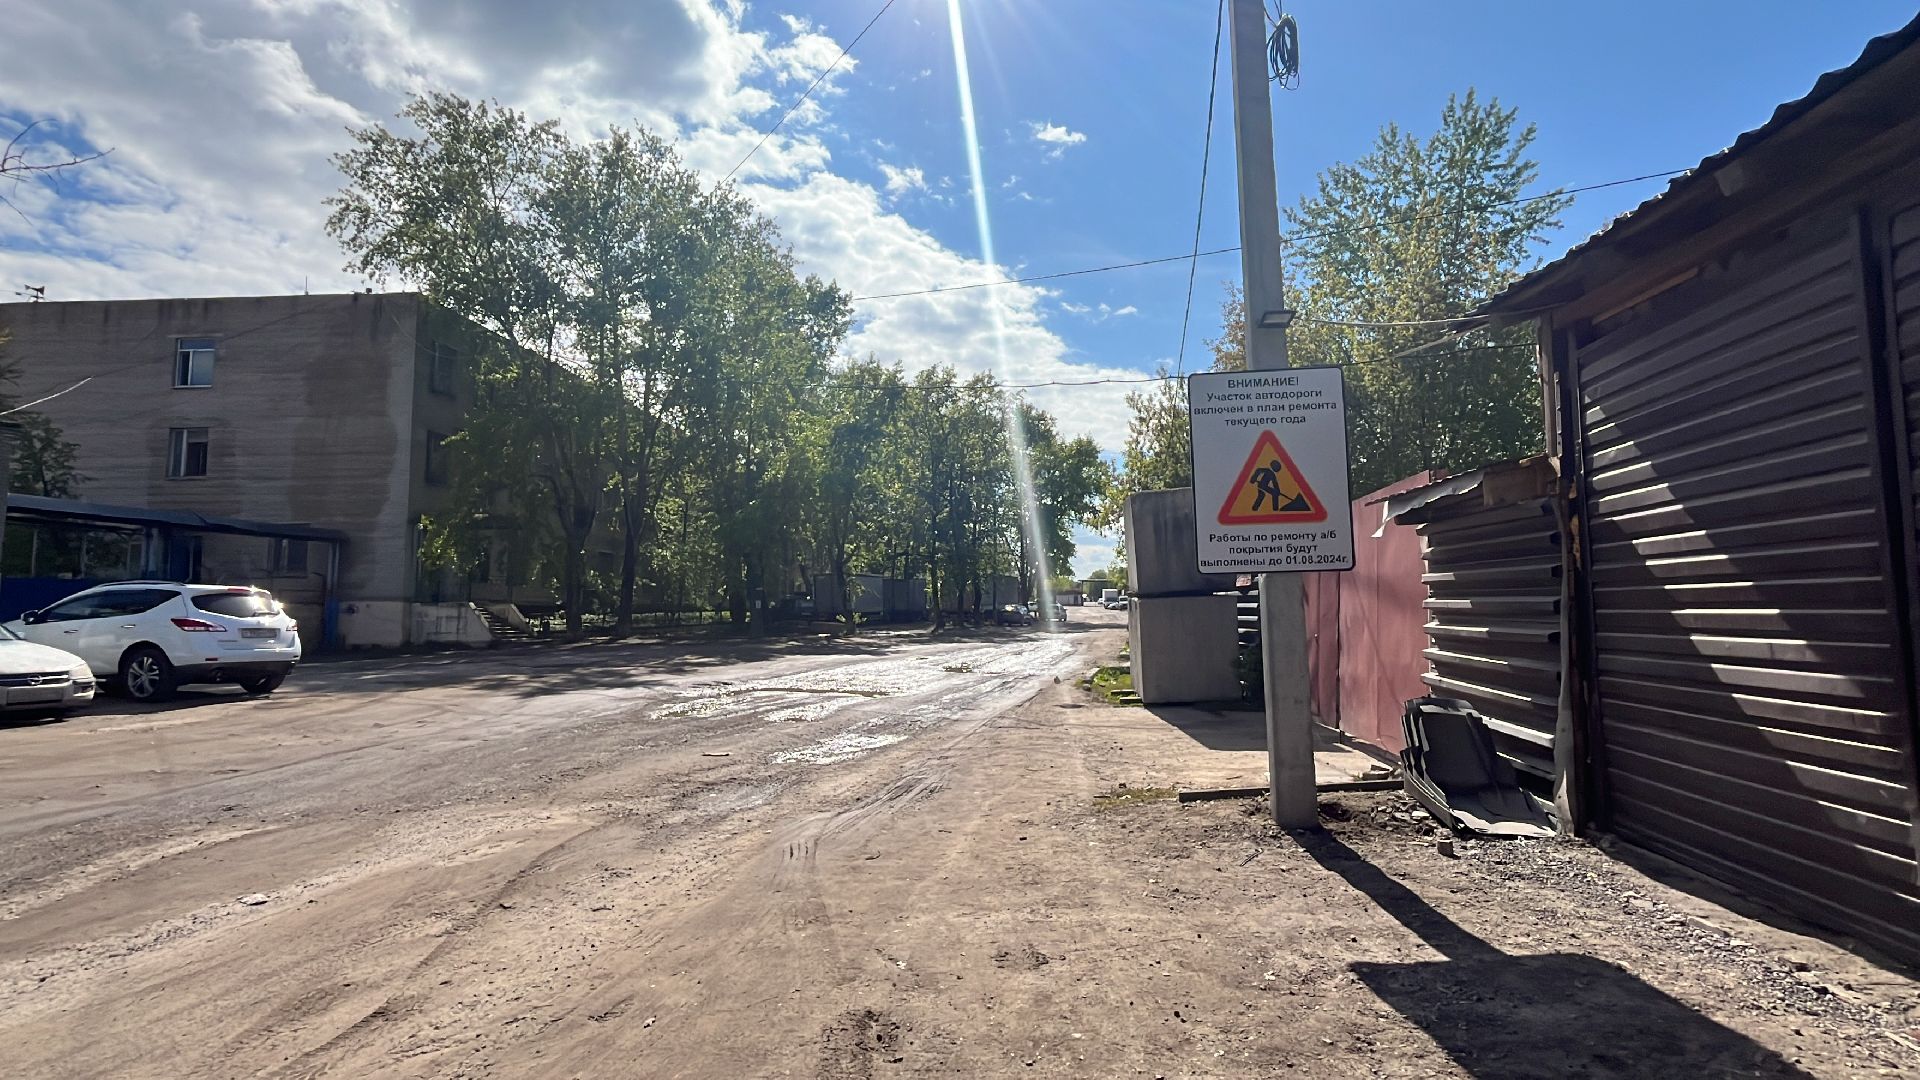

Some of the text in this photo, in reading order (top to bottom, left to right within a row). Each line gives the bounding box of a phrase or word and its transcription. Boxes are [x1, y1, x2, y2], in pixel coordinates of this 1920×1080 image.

[1227, 376, 1299, 388] ВНИМАНИЕ!
[1207, 389, 1322, 402] Участок автодороги
[1193, 406, 1243, 415] включен
[1257, 404, 1285, 412] план
[1289, 402, 1337, 412] ремонта
[1224, 416, 1306, 427] текущего года
[1209, 533, 1250, 542] Работы
[1271, 532, 1317, 542] ремонту
[1320, 530, 1336, 539] а/б
[1229, 544, 1318, 555] покрытия будут
[1200, 559, 1265, 567] выполнены
[1269, 558, 1282, 566] до
